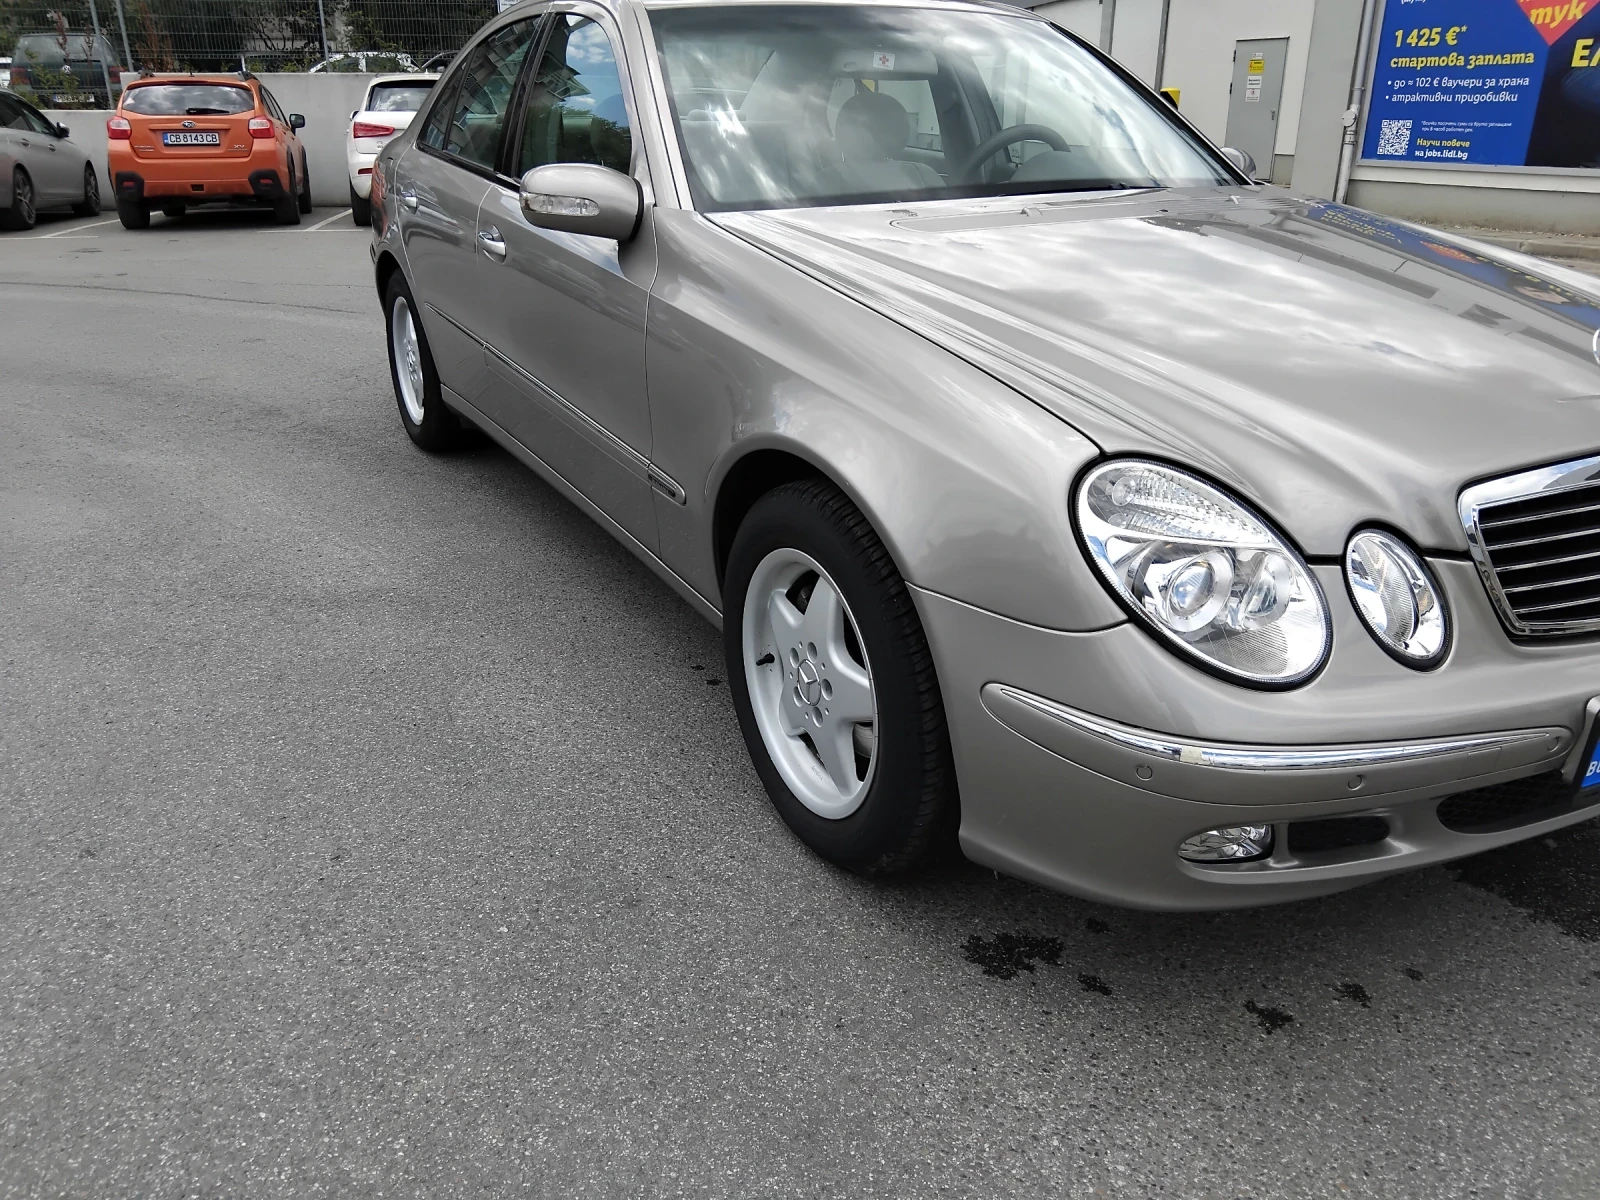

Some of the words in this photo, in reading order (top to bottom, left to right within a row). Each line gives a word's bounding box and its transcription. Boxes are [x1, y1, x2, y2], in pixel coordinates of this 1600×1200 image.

[1390, 52, 1464, 70] стартова
[1467, 52, 1534, 69] заплата
[1394, 80, 1406, 89] до
[1415, 77, 1431, 87] 102
[1433, 77, 1440, 87] €
[1441, 77, 1483, 89] ваучери
[1484, 78, 1496, 89] за
[1498, 77, 1530, 87] храна
[1391, 92, 1453, 104] атрактивни
[1455, 91, 1518, 104] придобивки
[169, 134, 182, 143] CB
[183, 134, 204, 143] 8143
[206, 134, 218, 143] CB
[1417, 138, 1440, 148] Научи
[1442, 138, 1470, 148] повече
[1425, 149, 1469, 160] jobs.lidl.bg
